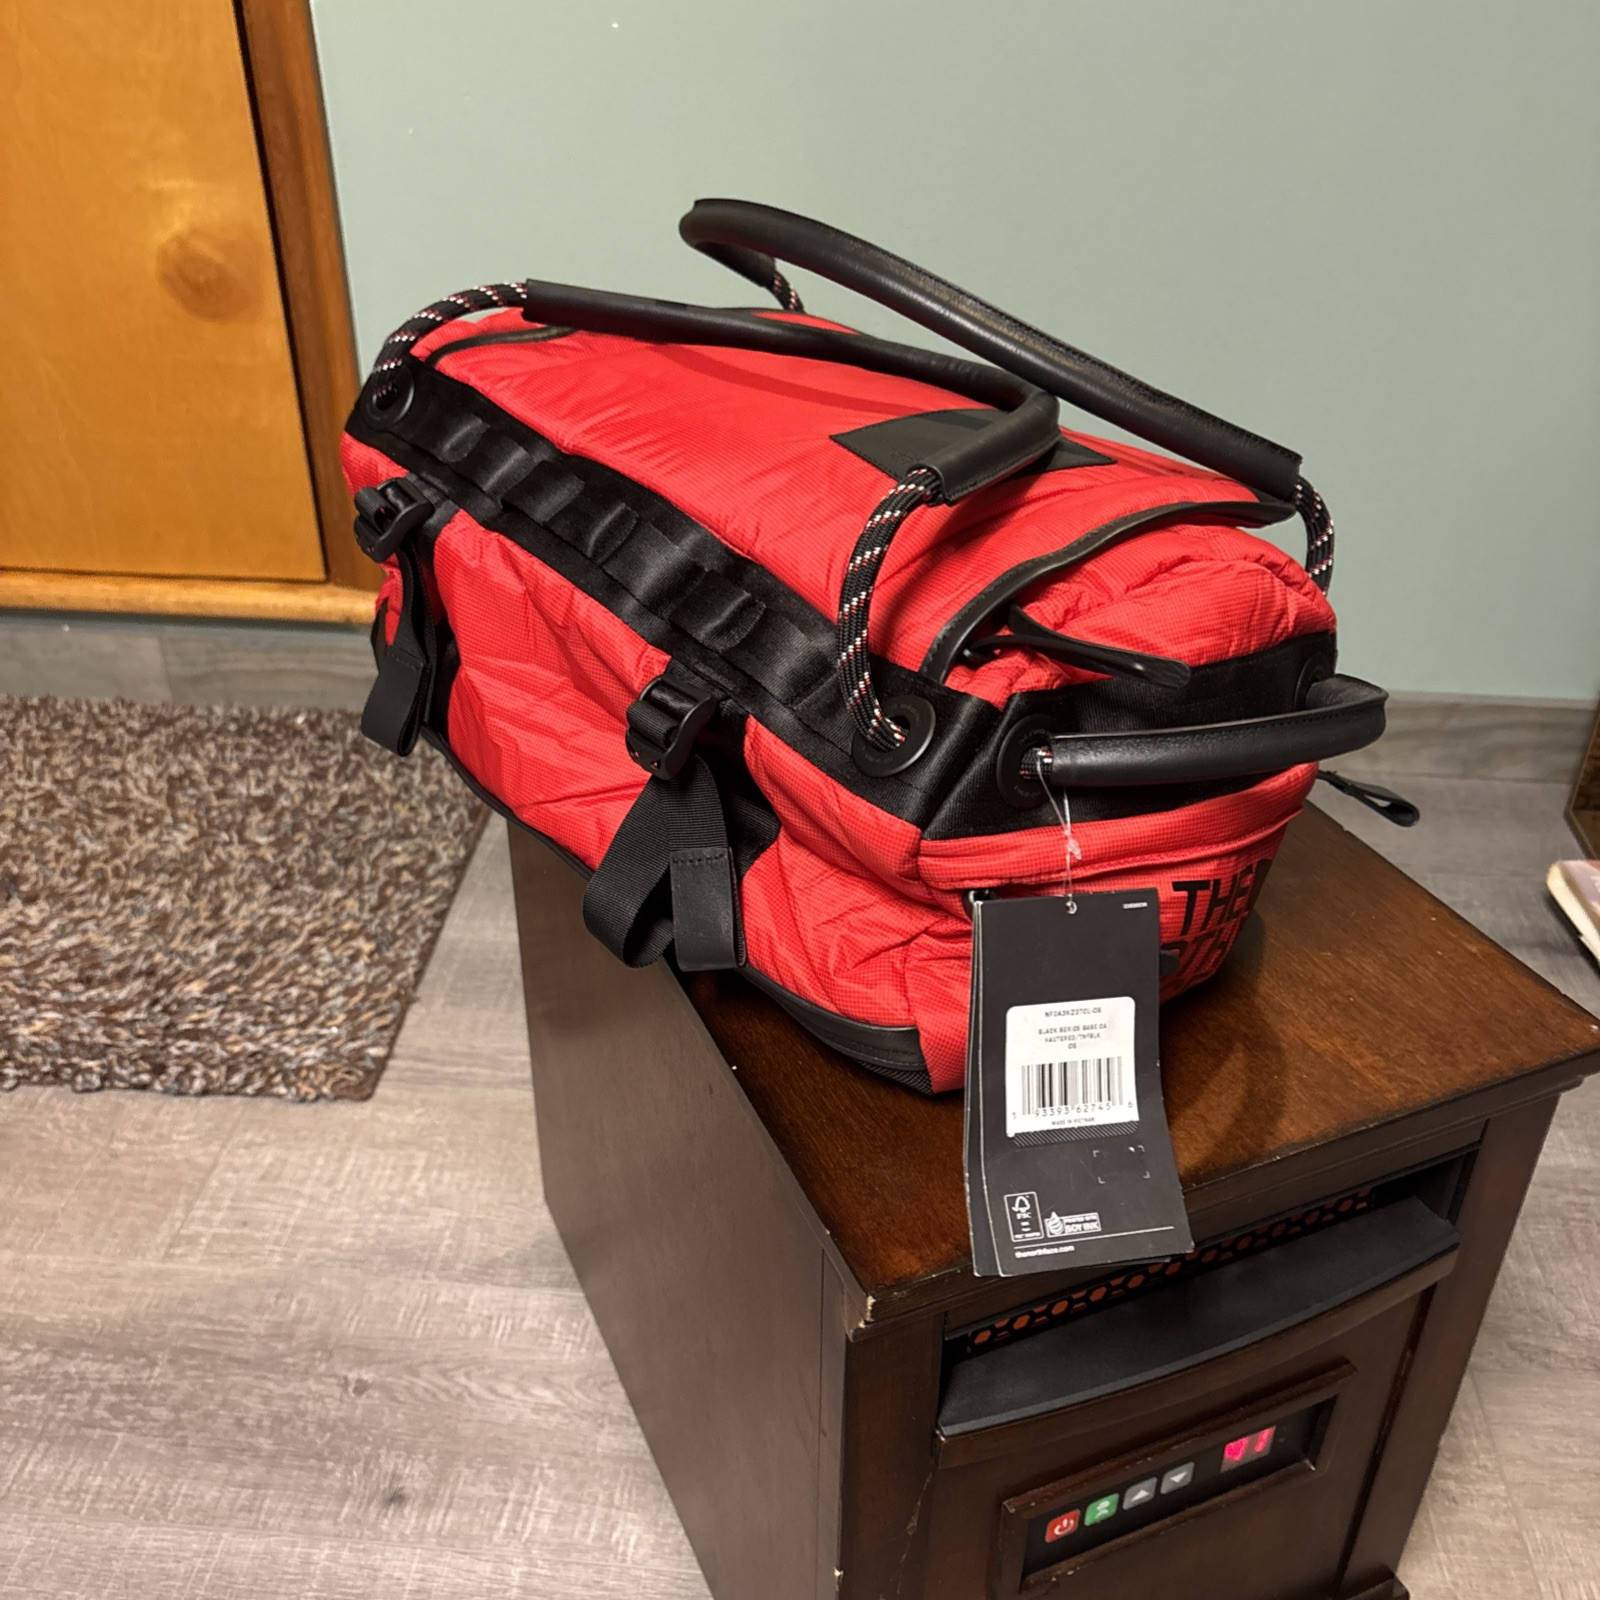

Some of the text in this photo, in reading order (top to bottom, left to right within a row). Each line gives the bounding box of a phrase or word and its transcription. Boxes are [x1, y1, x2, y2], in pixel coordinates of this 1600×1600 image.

[1059, 1025, 1080, 1033] SERIES
[1034, 1107, 1070, 1118] 93393
[1076, 1103, 1111, 1114] 62745
[1128, 1101, 1133, 1109] 6
